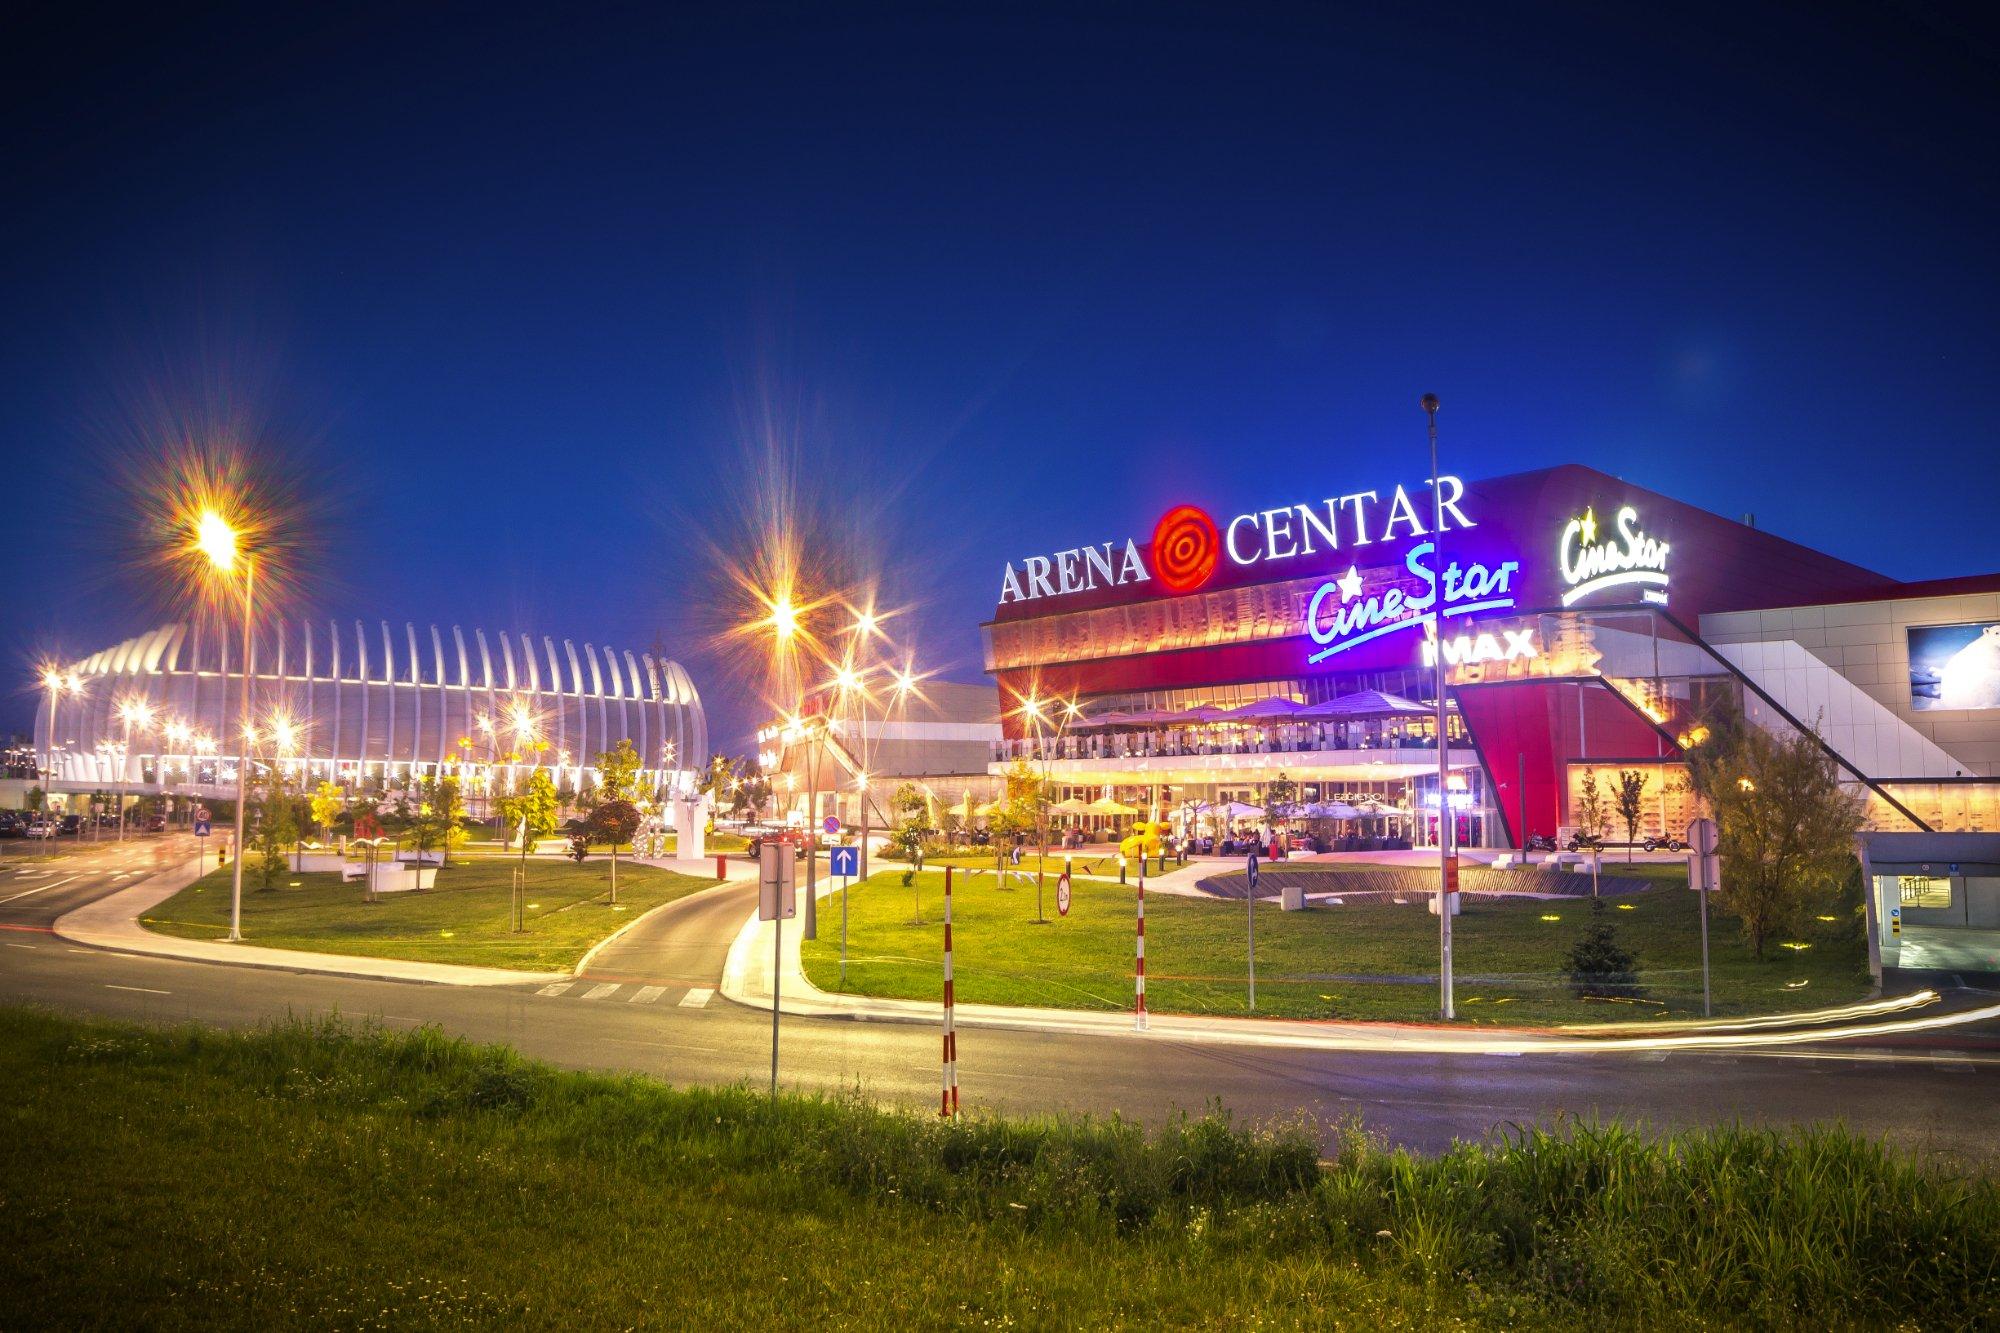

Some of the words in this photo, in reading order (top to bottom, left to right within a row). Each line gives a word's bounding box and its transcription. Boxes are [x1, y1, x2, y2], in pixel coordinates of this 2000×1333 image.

[999, 537, 1151, 605] ARENA
[1226, 475, 1478, 565] CENTAR
[1308, 542, 1519, 645] CineStar
[1422, 628, 1538, 667] IMAX
